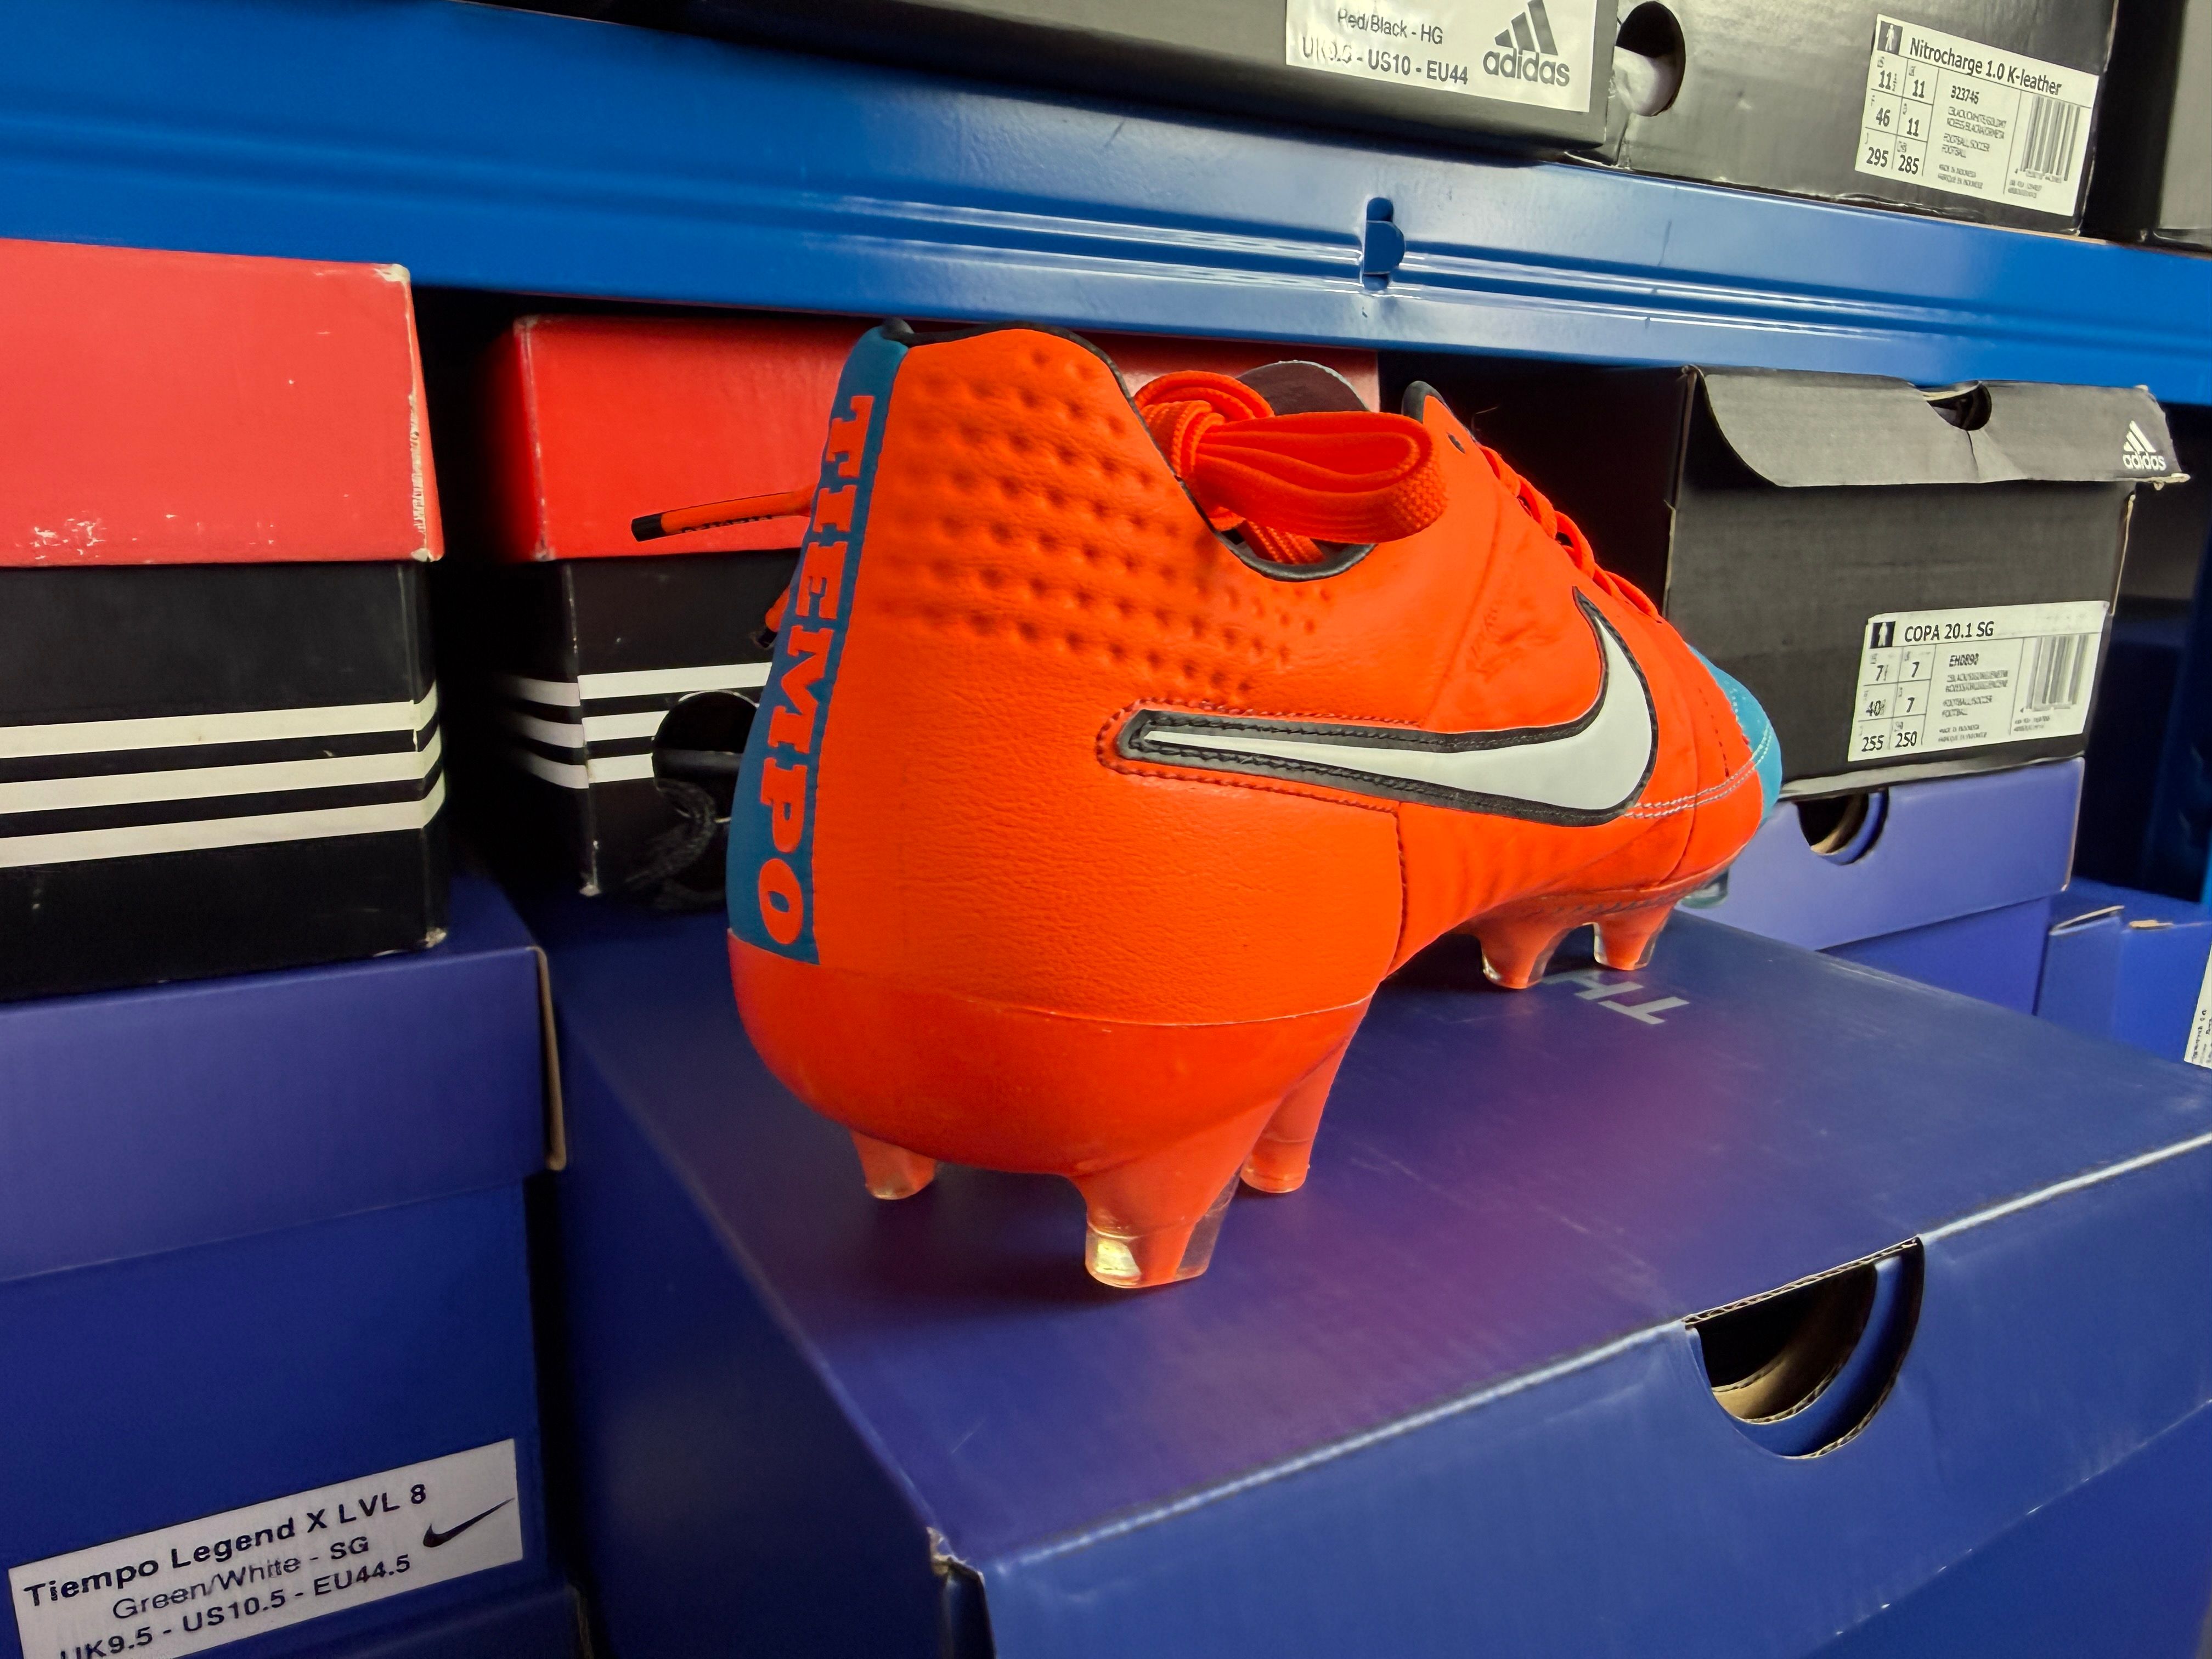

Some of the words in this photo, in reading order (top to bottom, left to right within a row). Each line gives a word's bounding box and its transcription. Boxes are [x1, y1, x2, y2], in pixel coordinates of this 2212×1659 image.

[1420, 24, 1443, 44] HG
[1368, 49, 1411, 76] US10
[1426, 60, 1469, 85] EU44
[1482, 48, 1571, 87] adidas
[1910, 37, 1983, 76] Nitrocharge
[1985, 60, 2005, 81] 1.0
[2007, 65, 2062, 96] K-leather
[1912, 78, 1925, 98] 11
[1876, 107, 1891, 127] 46
[1906, 117, 1920, 137] 11
[1866, 146, 1889, 168] 295
[1898, 154, 1920, 175] 285
[2122, 451, 2166, 471] adidas
[1904, 624, 1940, 642] COPA
[1944, 623, 1972, 640] 20.1
[1976, 620, 1995, 637] SG
[758, 394, 876, 945] TIEMPO
[1911, 661, 1920, 678] 7
[1906, 697, 1915, 713] 7
[1861, 735, 1885, 752] 255
[1894, 730, 1917, 748] 250
[23, 1559, 159, 1607] Tiempo
[171, 1516, 295, 1569] Legend
[307, 1508, 328, 1533] X
[338, 1492, 400, 1524] LVL
[410, 1483, 426, 1505] 8
[112, 1557, 301, 1619] Green/White
[330, 1536, 369, 1560] SG
[182, 1589, 286, 1632] US10.5
[313, 1554, 411, 1596] EU44.5
